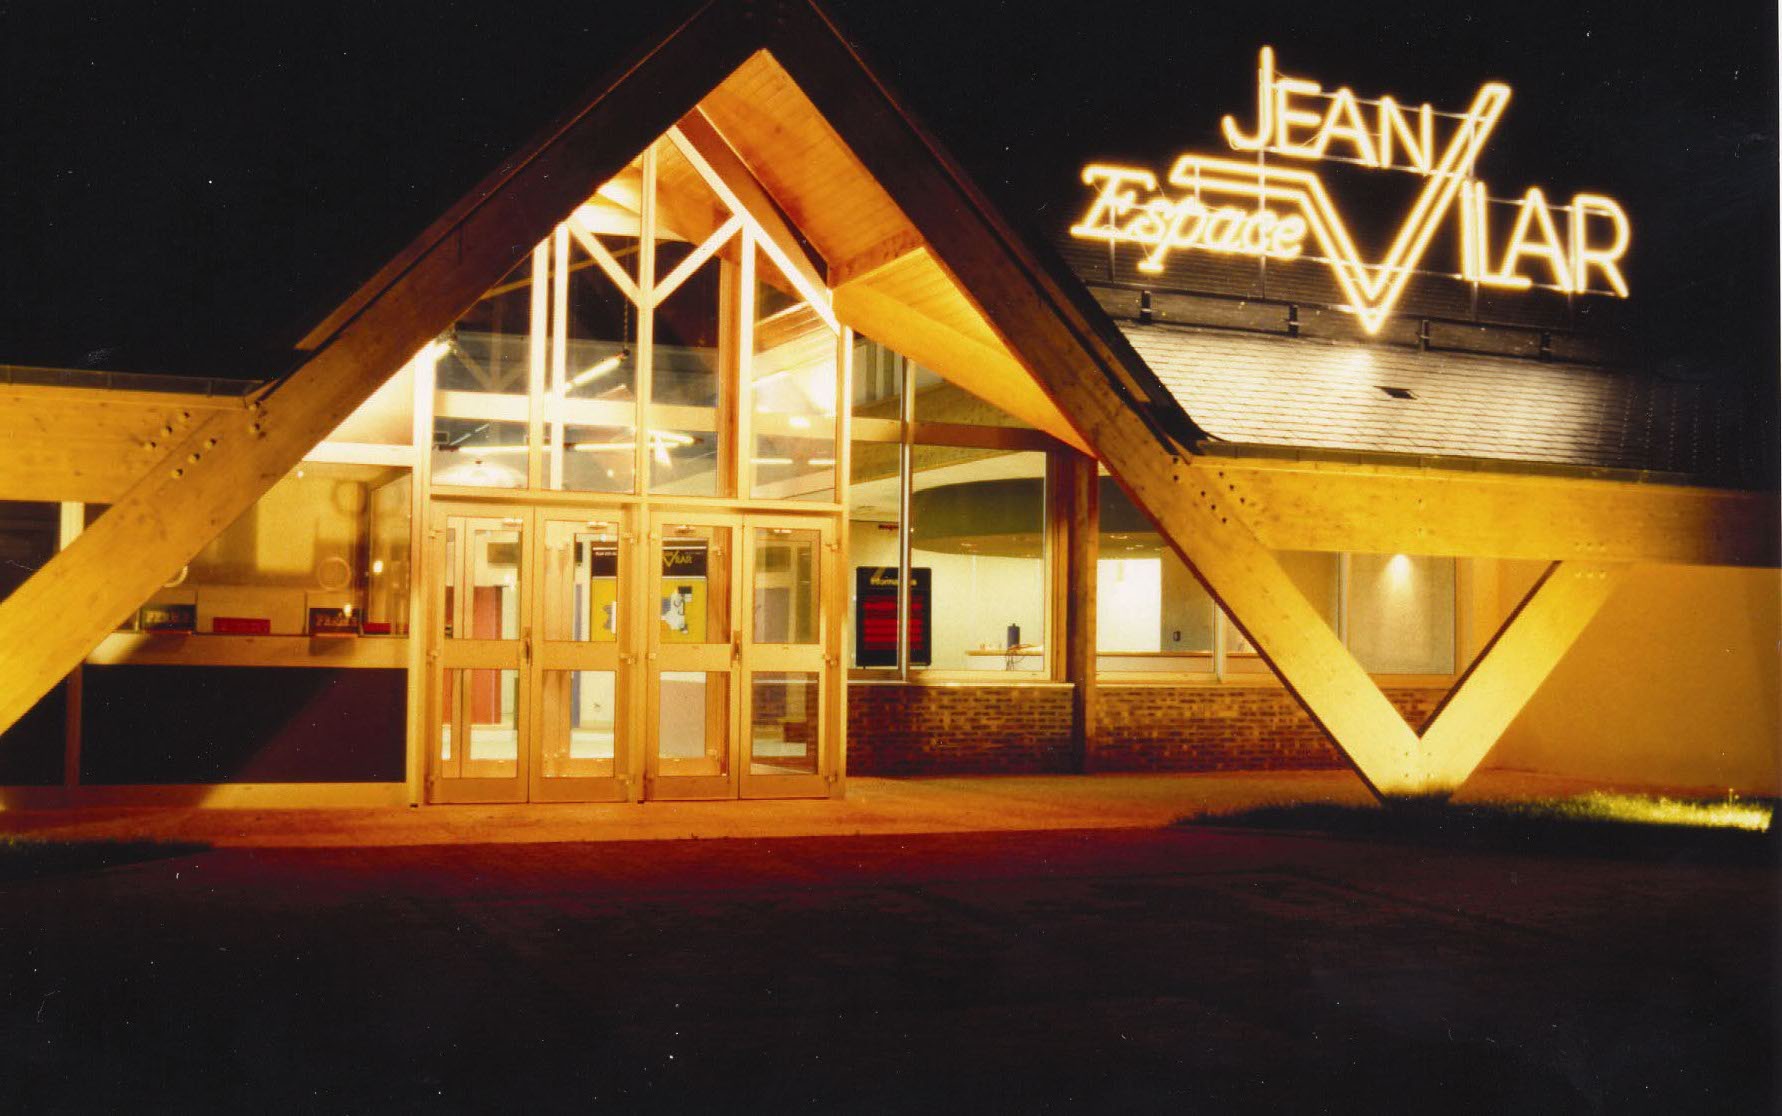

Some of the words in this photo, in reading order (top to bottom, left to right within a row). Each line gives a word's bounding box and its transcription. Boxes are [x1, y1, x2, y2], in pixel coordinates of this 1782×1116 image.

[1221, 45, 1433, 176] JEAN
[1070, 164, 1308, 273] Espace
[1169, 82, 1631, 335] VILAR
